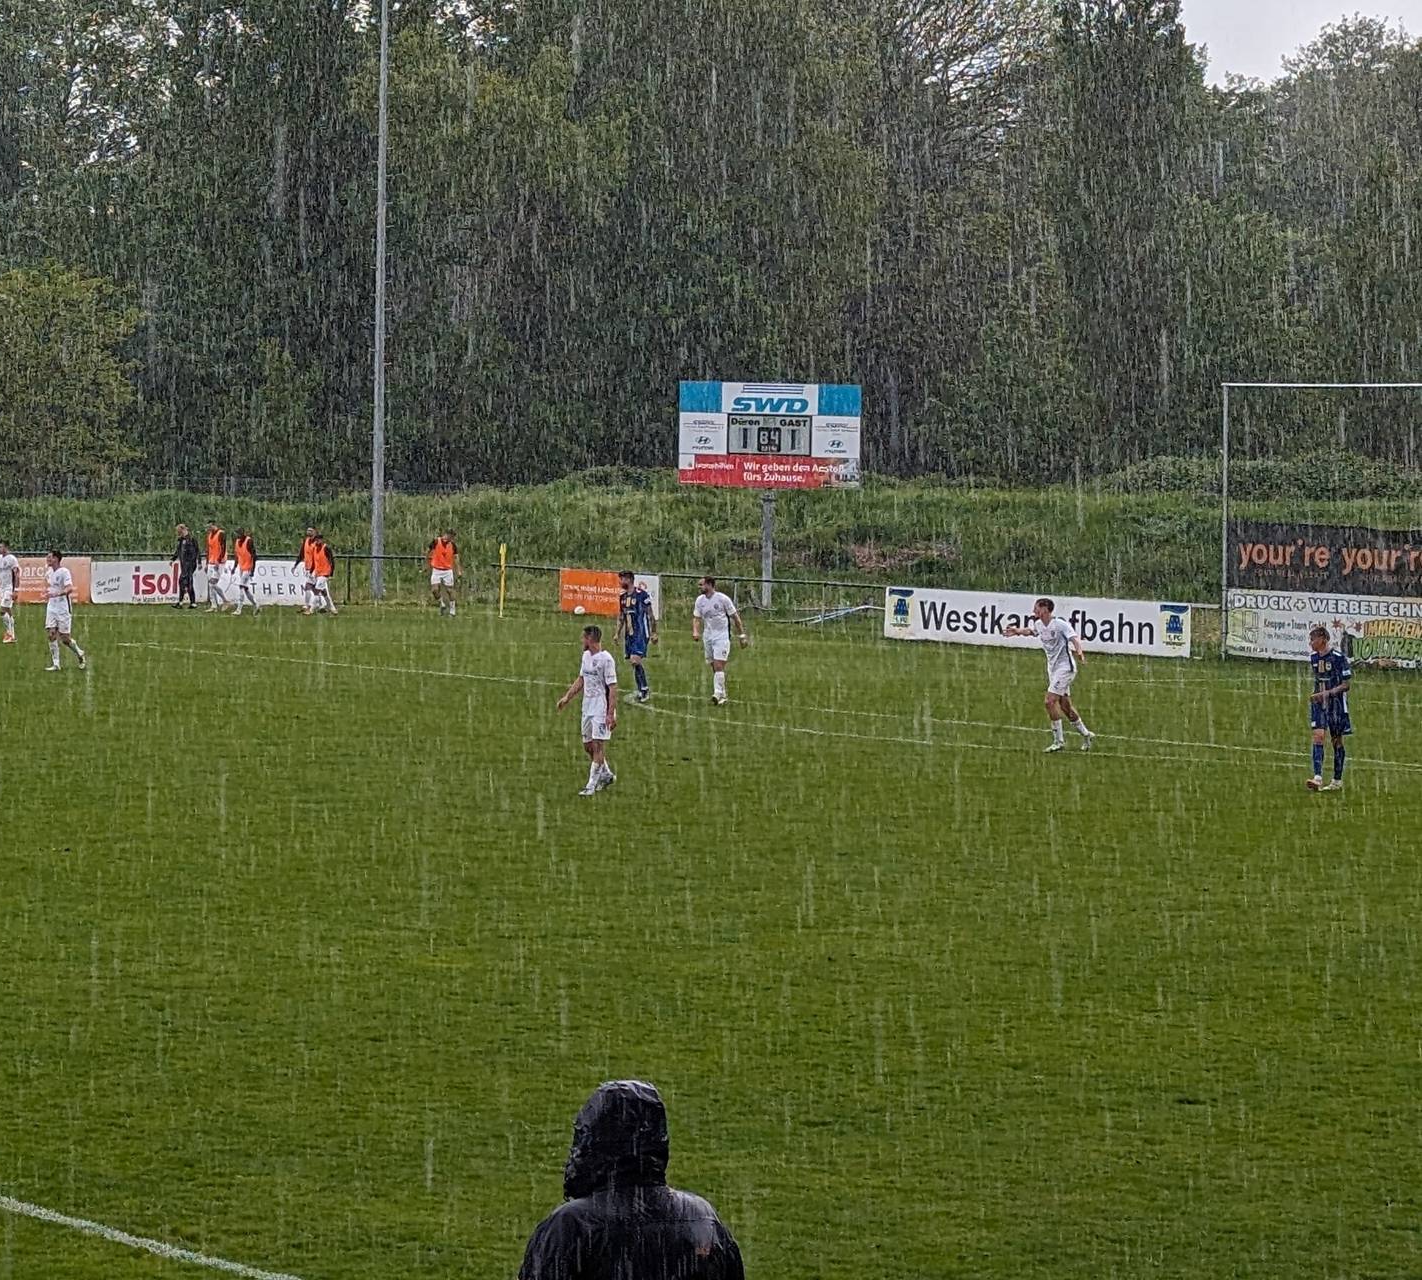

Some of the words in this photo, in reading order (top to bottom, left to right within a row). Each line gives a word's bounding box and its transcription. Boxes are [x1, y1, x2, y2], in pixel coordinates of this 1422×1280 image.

[731, 397, 809, 413] SWD
[731, 417, 760, 426] Düren
[779, 419, 808, 427] GAST
[743, 462, 760, 470] Wir
[762, 463, 791, 473] geben
[793, 463, 810, 471] den
[743, 472, 761, 481] fürs
[132, 563, 179, 595] isol
[1234, 594, 1292, 611] DRUCK
[1308, 597, 1422, 618] WERBETECHN
[919, 600, 1154, 645] Westkafbahn
